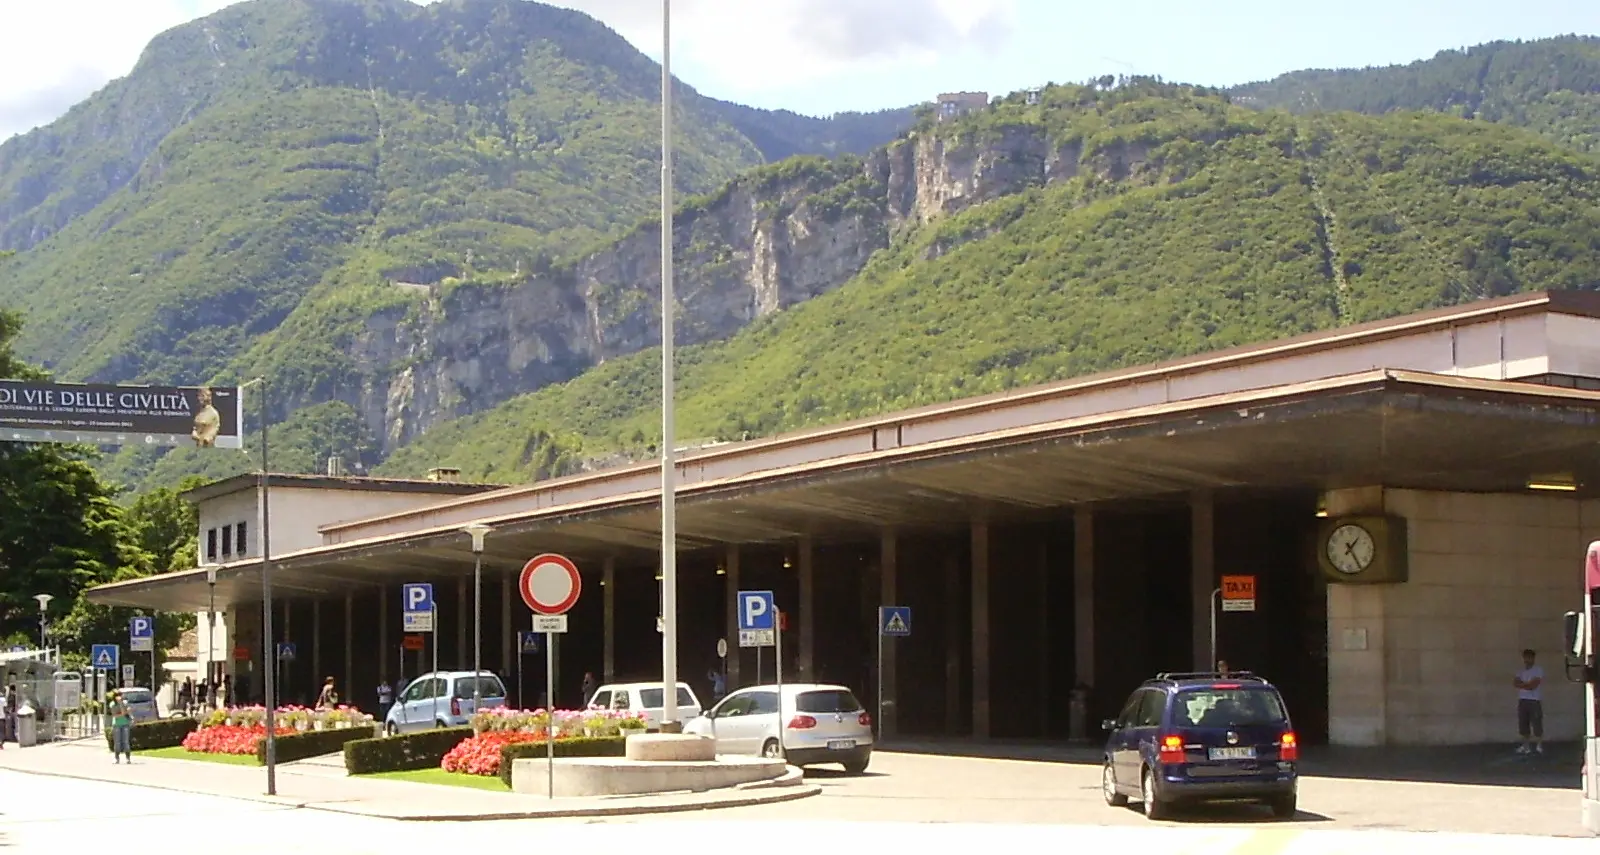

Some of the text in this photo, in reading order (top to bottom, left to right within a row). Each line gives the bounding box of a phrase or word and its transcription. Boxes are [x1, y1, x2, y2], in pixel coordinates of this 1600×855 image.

[24, 389, 53, 405] VIE
[61, 391, 114, 407] DELLE
[119, 391, 189, 409] CIVILTÀ
[1225, 582, 1252, 593] TAXI
[409, 587, 426, 610] P
[745, 595, 766, 626] P
[134, 619, 148, 636] P
